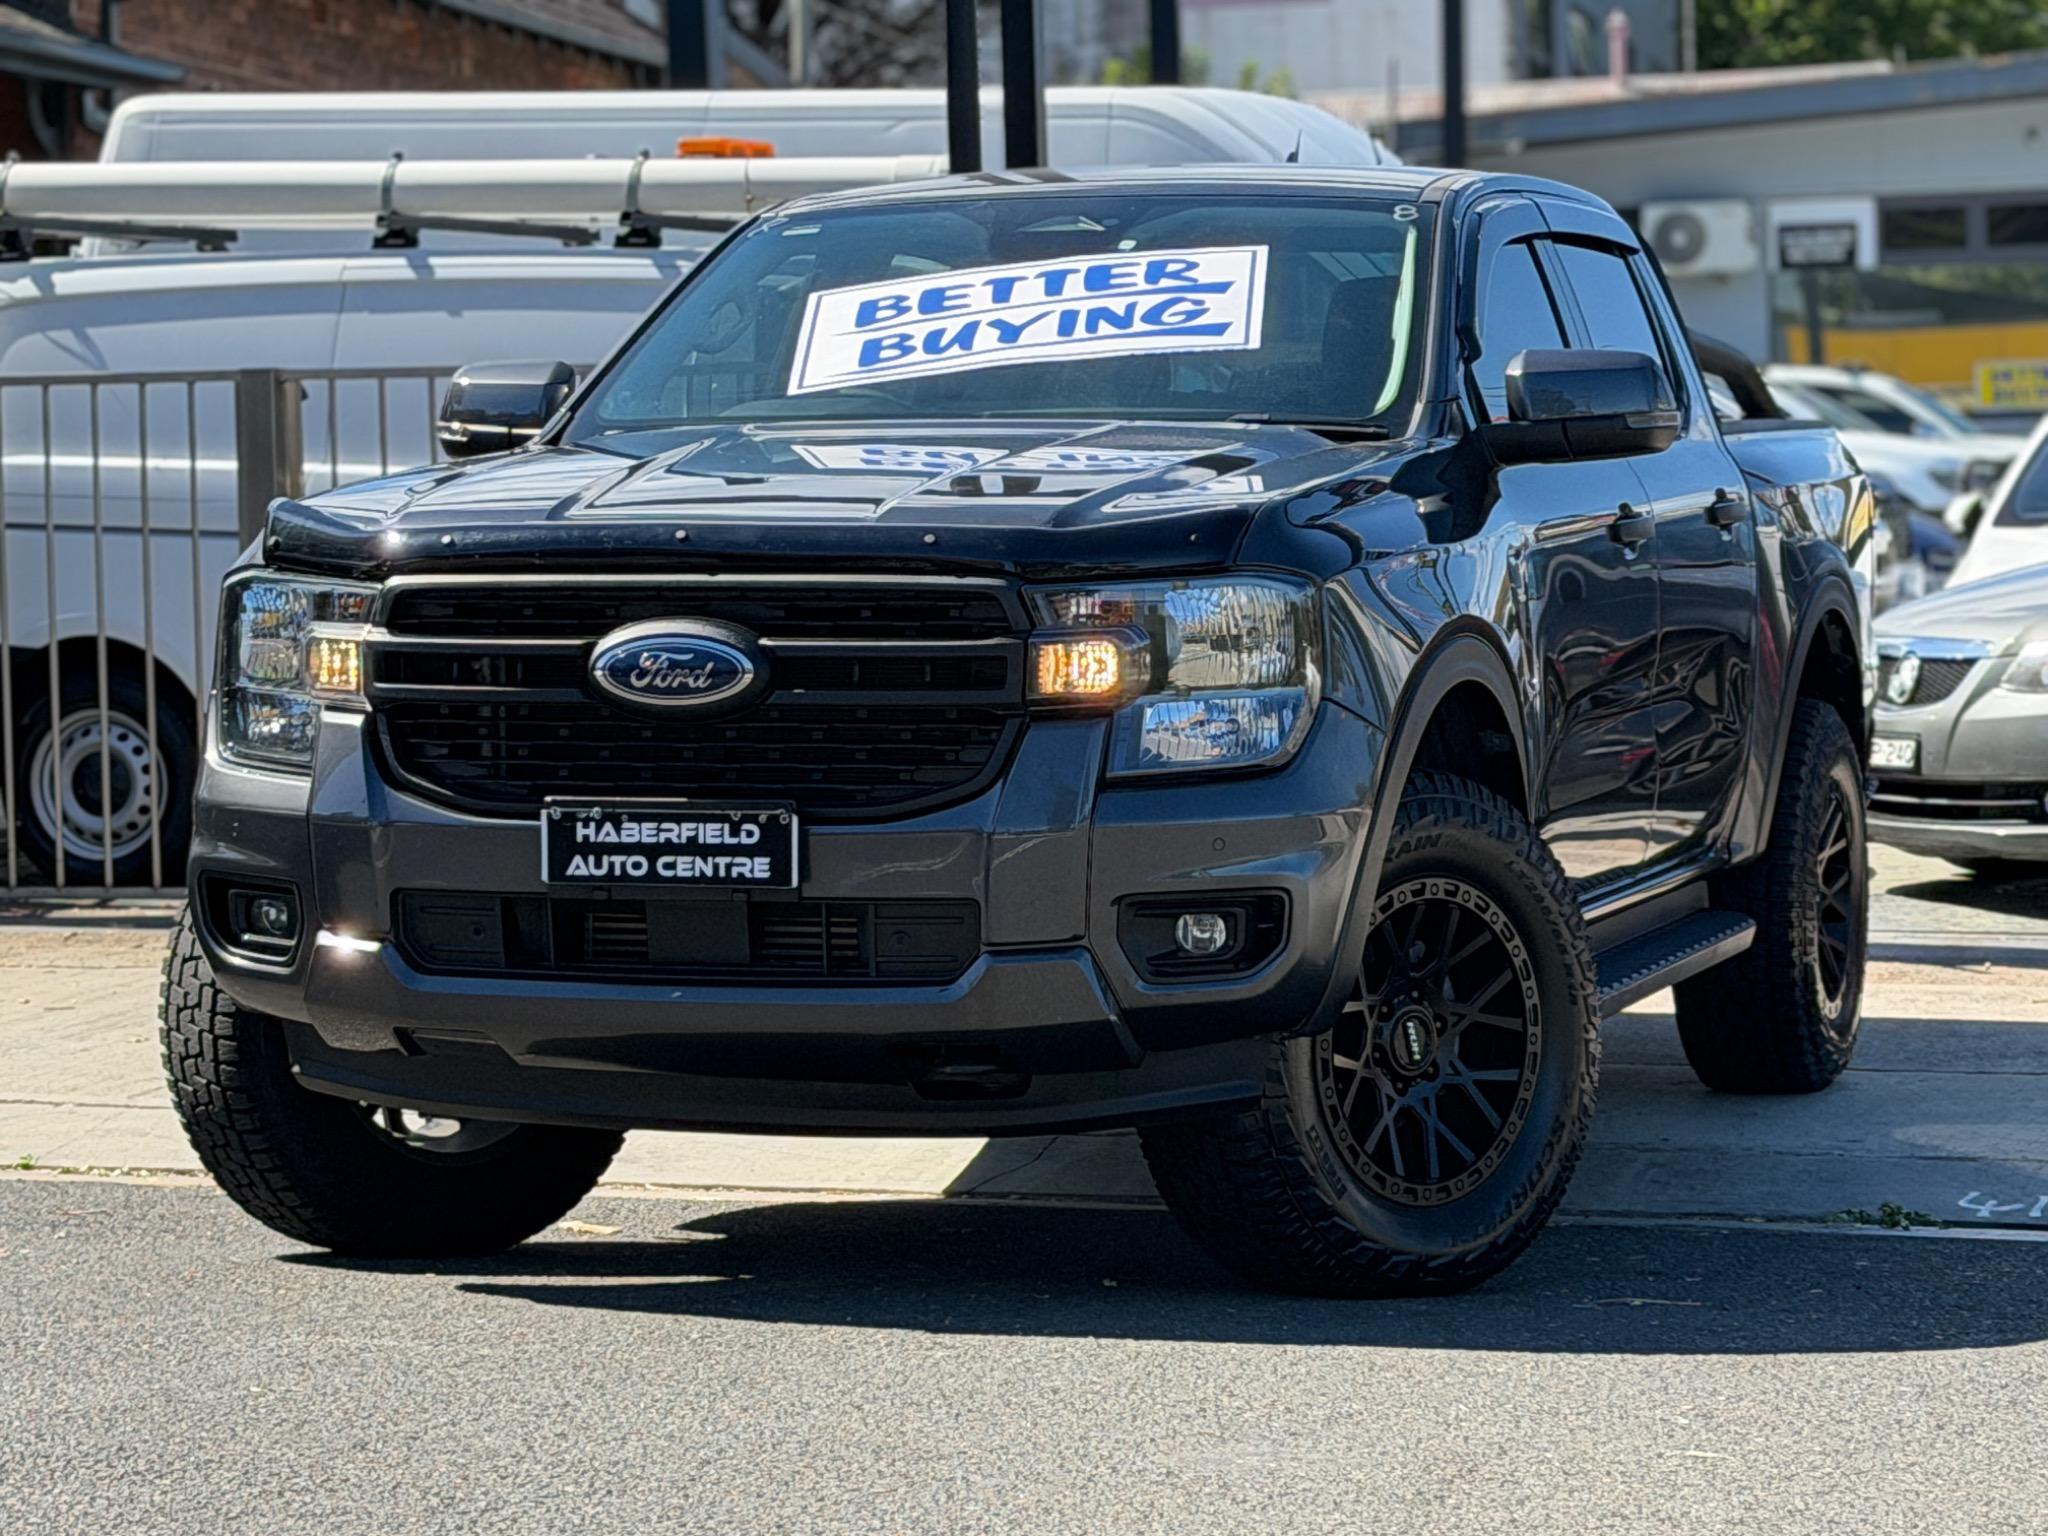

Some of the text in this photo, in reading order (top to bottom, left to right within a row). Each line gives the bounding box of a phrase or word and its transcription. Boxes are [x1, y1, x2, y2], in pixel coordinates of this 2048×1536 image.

[854, 258, 1201, 328] BETTER
[857, 296, 1212, 369] BUYING
[629, 651, 715, 688] Ford
[575, 821, 761, 845] HABERFIELD
[564, 854, 772, 879] AUTO CENTRE
